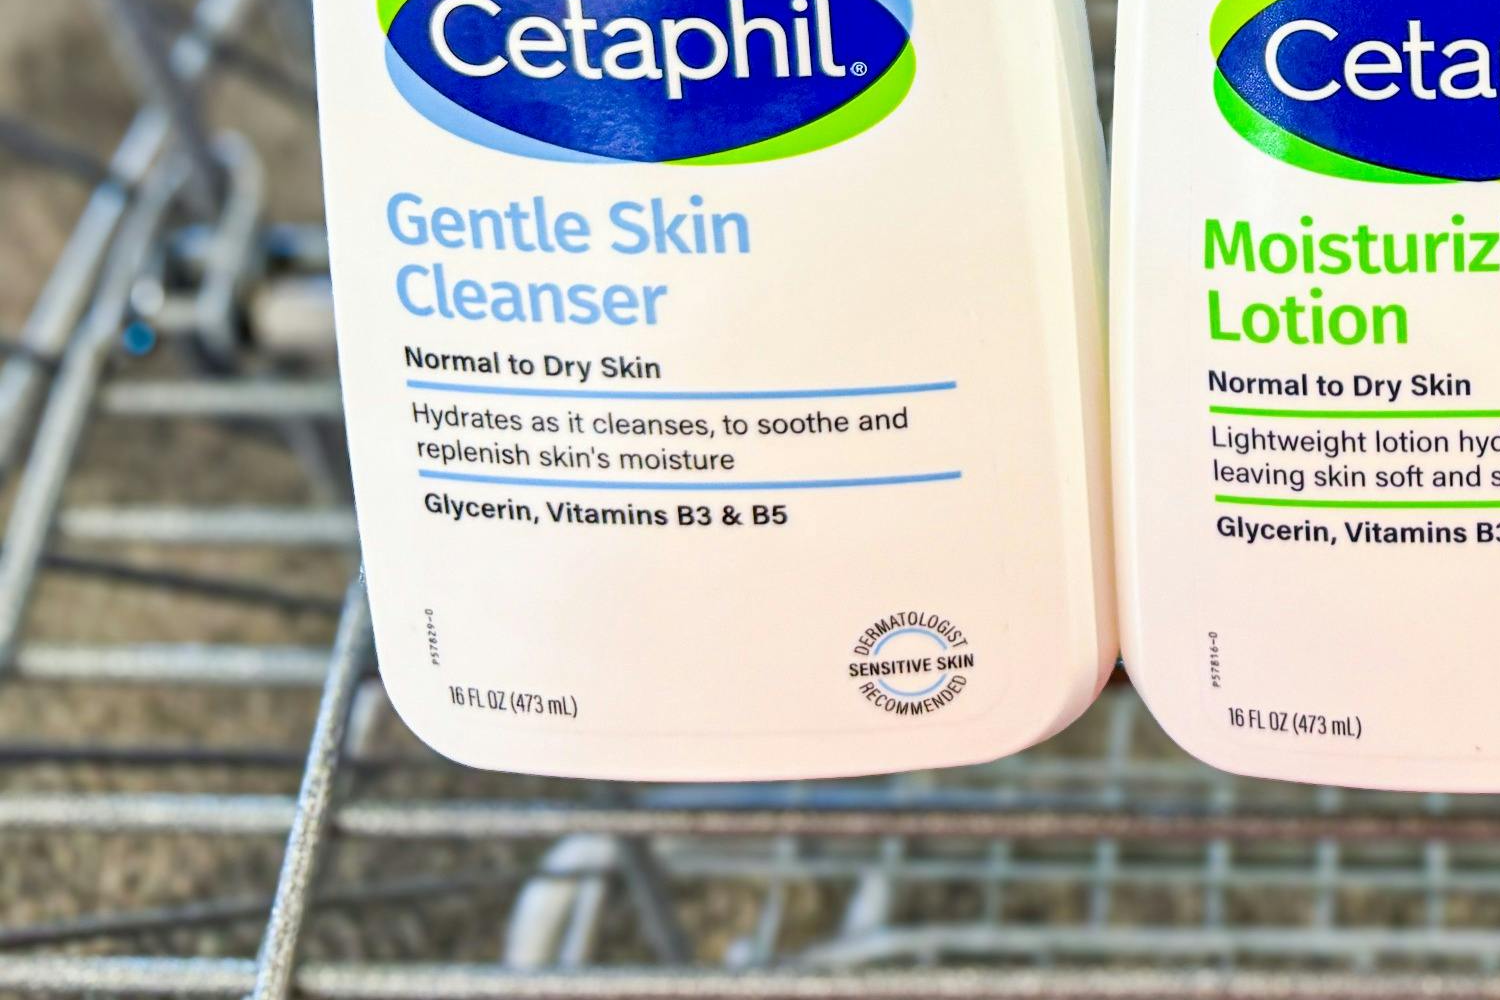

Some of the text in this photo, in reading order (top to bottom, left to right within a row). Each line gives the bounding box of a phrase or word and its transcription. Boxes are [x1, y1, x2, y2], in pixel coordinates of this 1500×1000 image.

[387, 192, 750, 254] Gentle Skin
[396, 263, 667, 325] Cleanser
[1208, 287, 1408, 346] Lotion
[405, 346, 660, 383] Normal to Dry Skin
[1209, 370, 1470, 402] Normal to Dry Skin
[413, 402, 907, 438] Hydrates as it cleanses, to soothe and
[418, 440, 734, 470] replenish skin's moisture
[1213, 426, 1366, 458] Lightweight
[1376, 430, 1448, 452] lotion
[1214, 459, 1304, 491] leaving
[1315, 465, 1365, 487] skin
[1376, 465, 1423, 487] soft
[1433, 465, 1480, 487] and
[425, 493, 787, 526] Glycerin, Vitamins B3 & B5
[1217, 516, 1336, 545] Glycerin,
[1345, 522, 1467, 543] Vitamins
[854, 612, 967, 655] DERMATOLOGIST
[850, 654, 973, 676] SENSITIVE SKIN
[450, 686, 577, 718] 16 FL OZ (473 mL)
[860, 676, 966, 715] RECOMMENDED
[1229, 708, 1361, 739] 16 FL OZ (473 mL)
